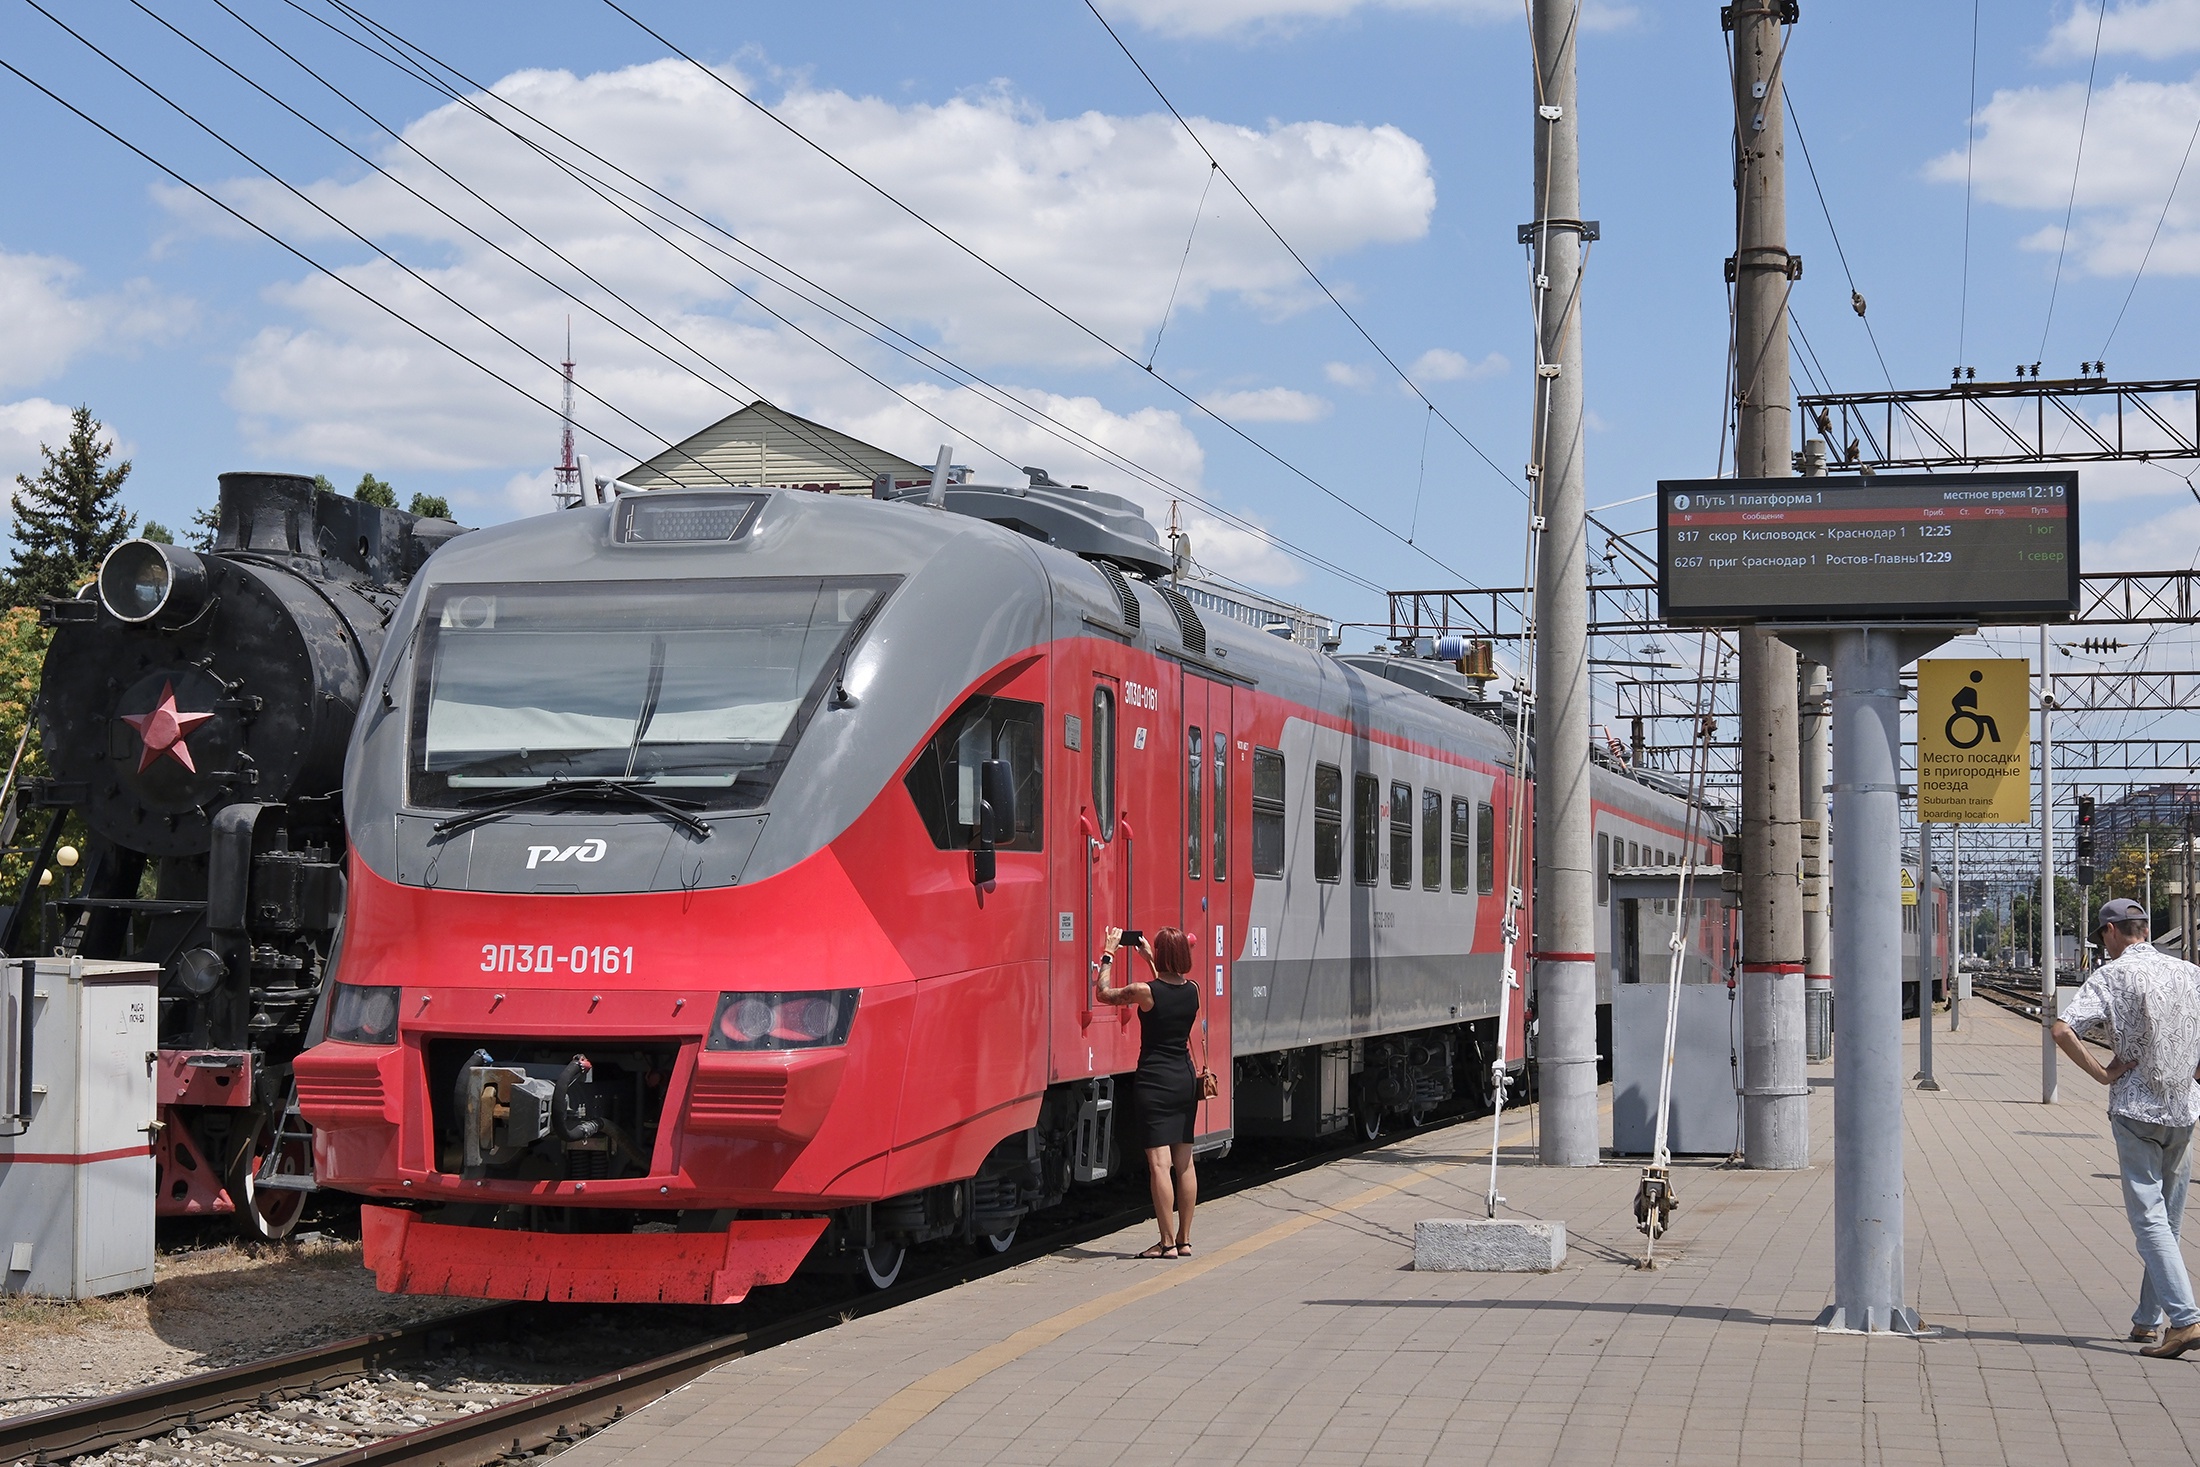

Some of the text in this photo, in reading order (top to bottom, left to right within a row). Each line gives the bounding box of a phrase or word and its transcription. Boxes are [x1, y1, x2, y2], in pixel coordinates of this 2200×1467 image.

[1696, 492, 1822, 509] Путь 1 платформа 1
[1943, 485, 2064, 501] местное время 12:19
[1741, 512, 1785, 522] Сообщение
[1923, 508, 1945, 517] Приб.
[1959, 508, 1970, 516] Ст.
[1984, 507, 2006, 517] Отпр.
[2031, 506, 2049, 515] Путь
[1677, 530, 1700, 542] 817
[1708, 533, 1738, 544] скор
[1742, 529, 1816, 541] Кисловодск
[1827, 527, 1897, 541] Краснодар
[1900, 527, 1906, 538] 1
[1919, 525, 1952, 538] 12:25
[2028, 524, 2034, 535] 1
[2037, 525, 2054, 536] юг
[1674, 556, 1703, 569] 6267
[1709, 559, 1739, 570] приг
[1810, 554, 1816, 565] 1
[1825, 554, 1919, 566] Ростов-Главны
[1919, 551, 1952, 564] 12:29
[2018, 550, 2024, 561] 1
[2027, 552, 2064, 564] север
[1125, 680, 1158, 711] ЭП3Д-0161
[1923, 752, 2021, 767] Место посадки
[1923, 767, 2020, 779] в пригородные
[1923, 781, 1969, 792] поезда
[1923, 796, 1994, 806] Suburban trains
[1923, 809, 2000, 820] boarding location
[480, 944, 634, 975] ЭП3Д-0161
